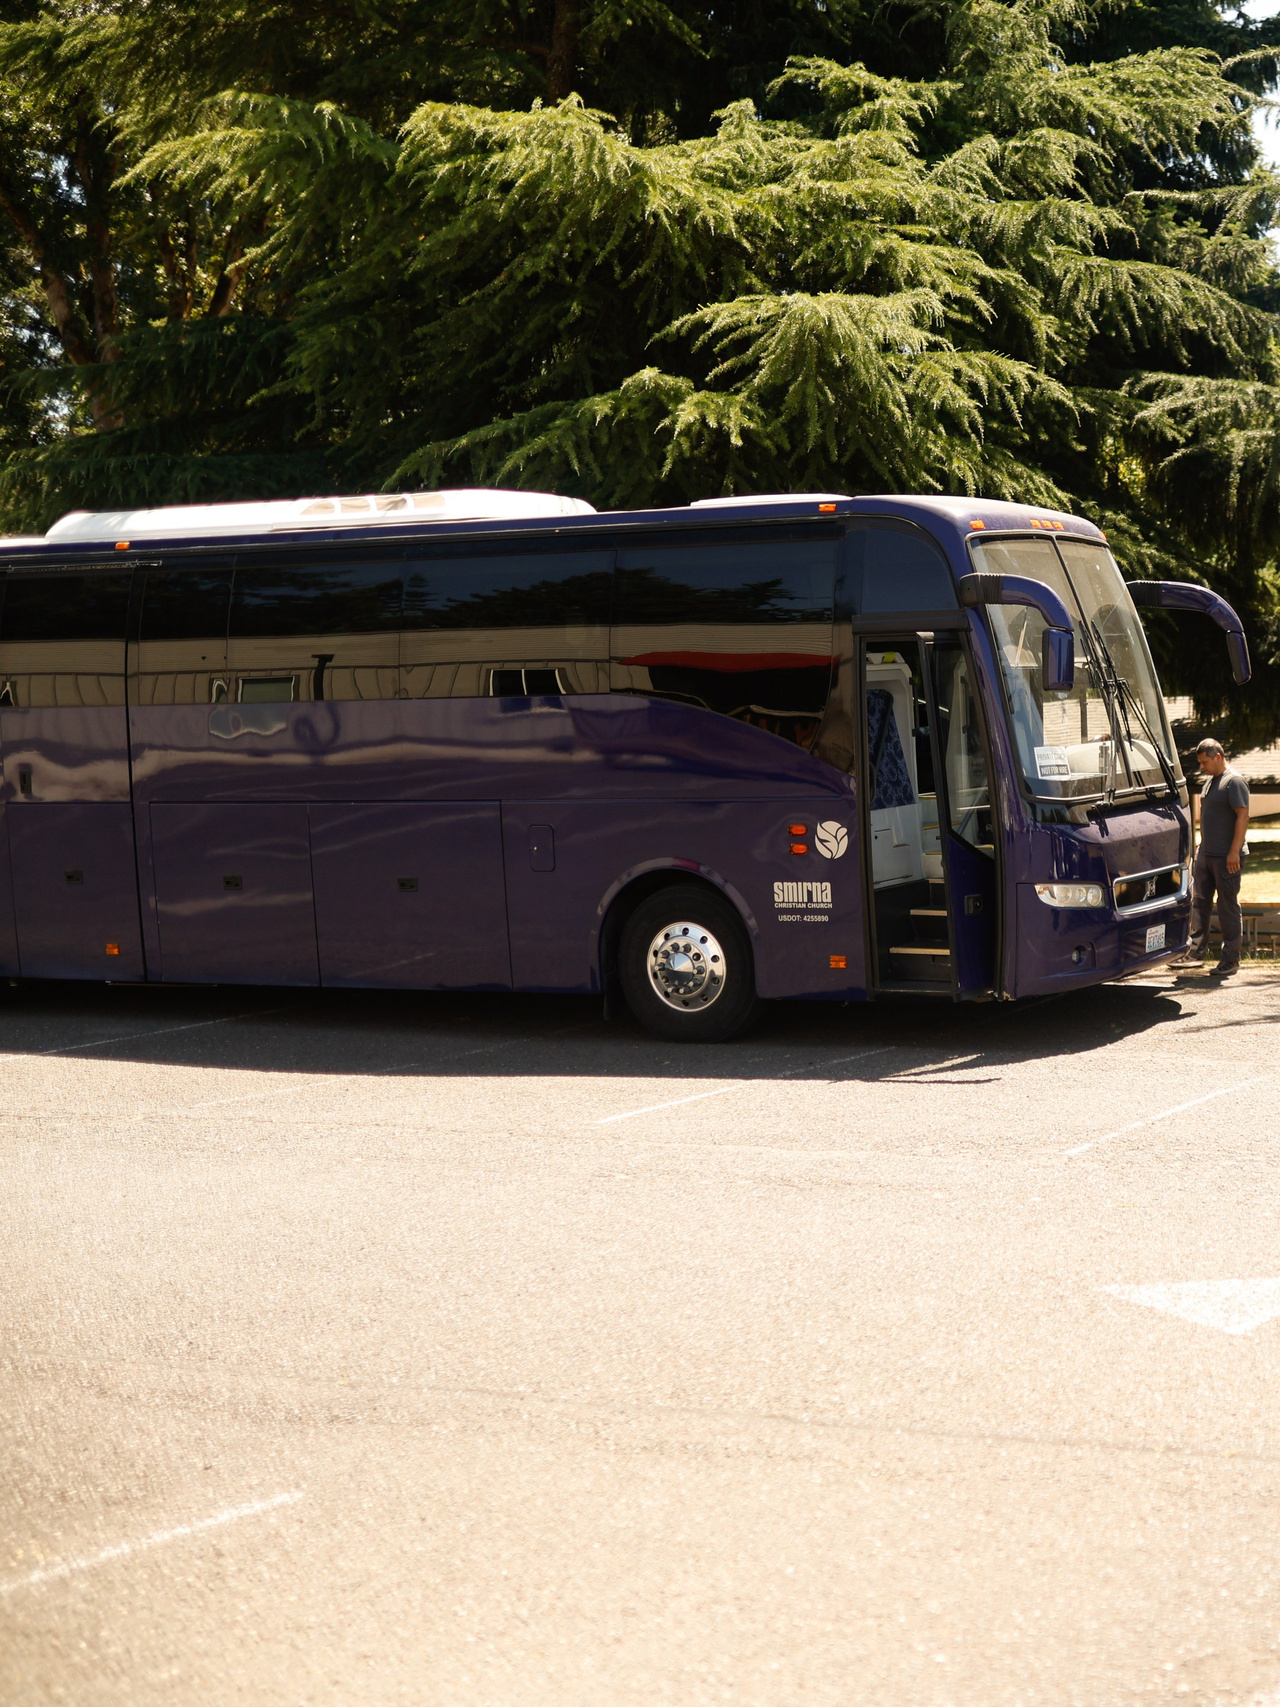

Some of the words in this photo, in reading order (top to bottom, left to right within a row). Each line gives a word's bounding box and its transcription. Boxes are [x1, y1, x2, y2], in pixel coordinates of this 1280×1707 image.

[1041, 766, 1051, 775] NOT
[1051, 766, 1059, 774] FOR
[774, 882, 832, 902] smirna
